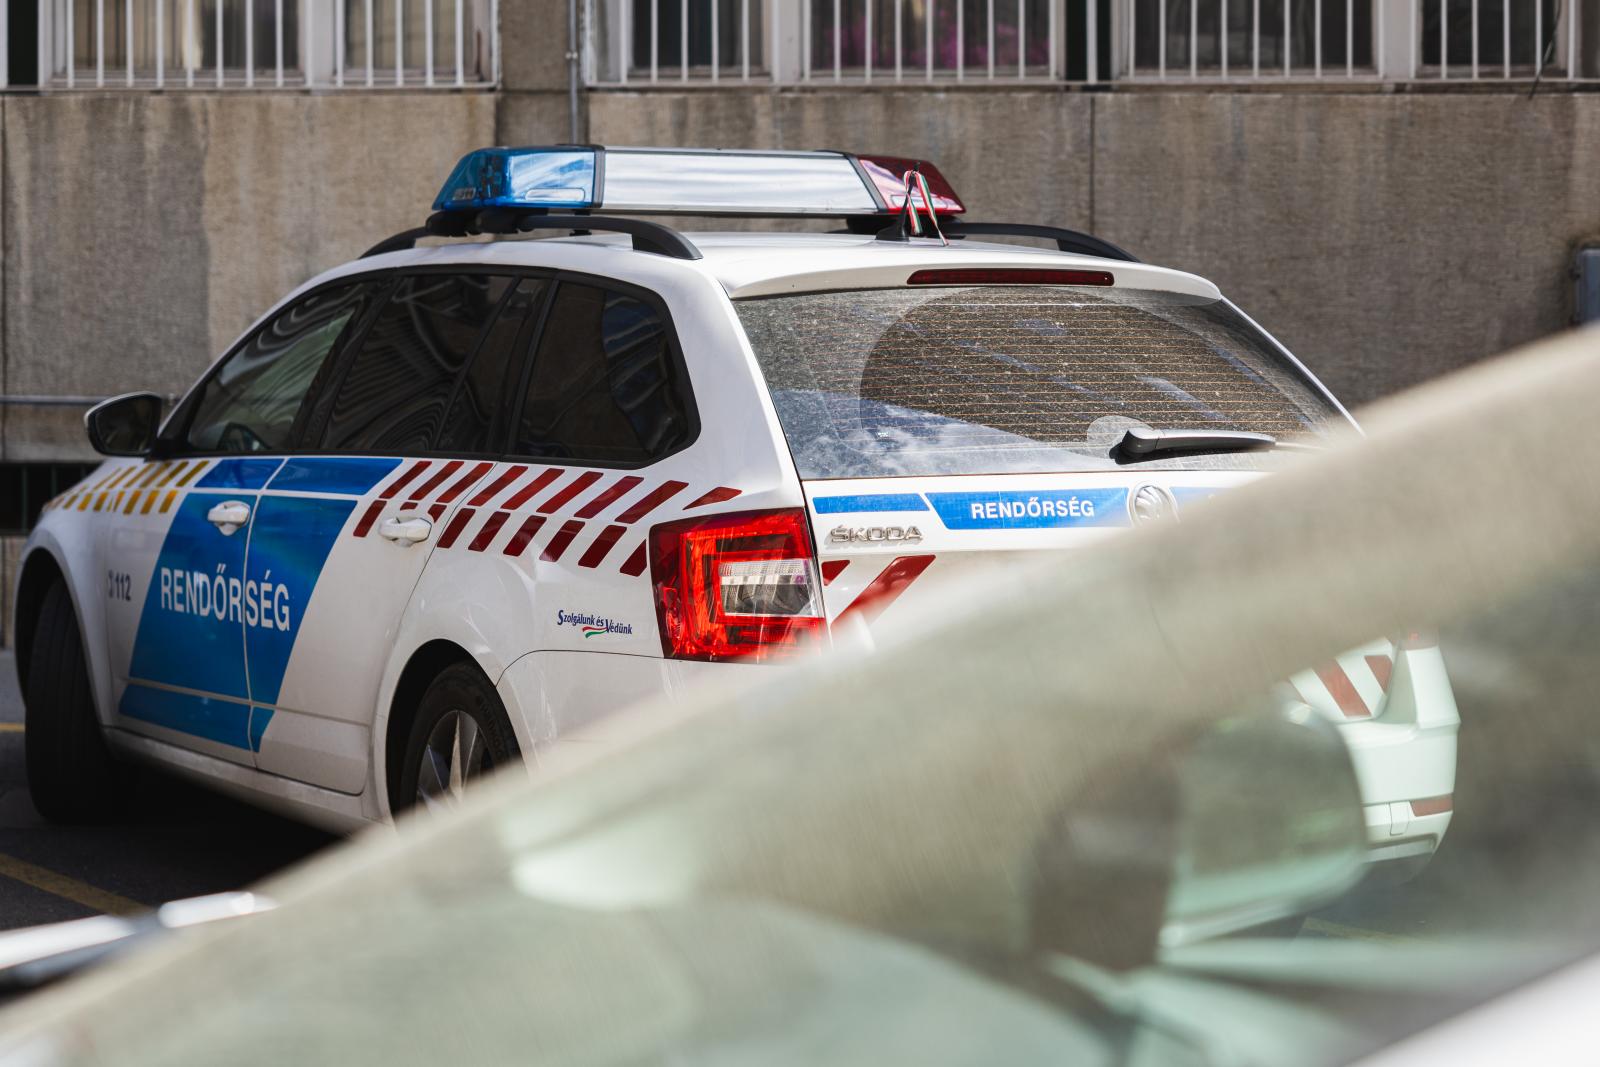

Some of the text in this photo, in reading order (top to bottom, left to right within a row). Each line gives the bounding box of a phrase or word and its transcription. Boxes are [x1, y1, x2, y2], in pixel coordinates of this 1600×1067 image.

[971, 496, 1095, 519] RENDŐRSÉG
[115, 572, 131, 602] 112
[161, 563, 290, 632] RENDŐRSÉG
[557, 609, 633, 634] Szolgálunk és Védünk
